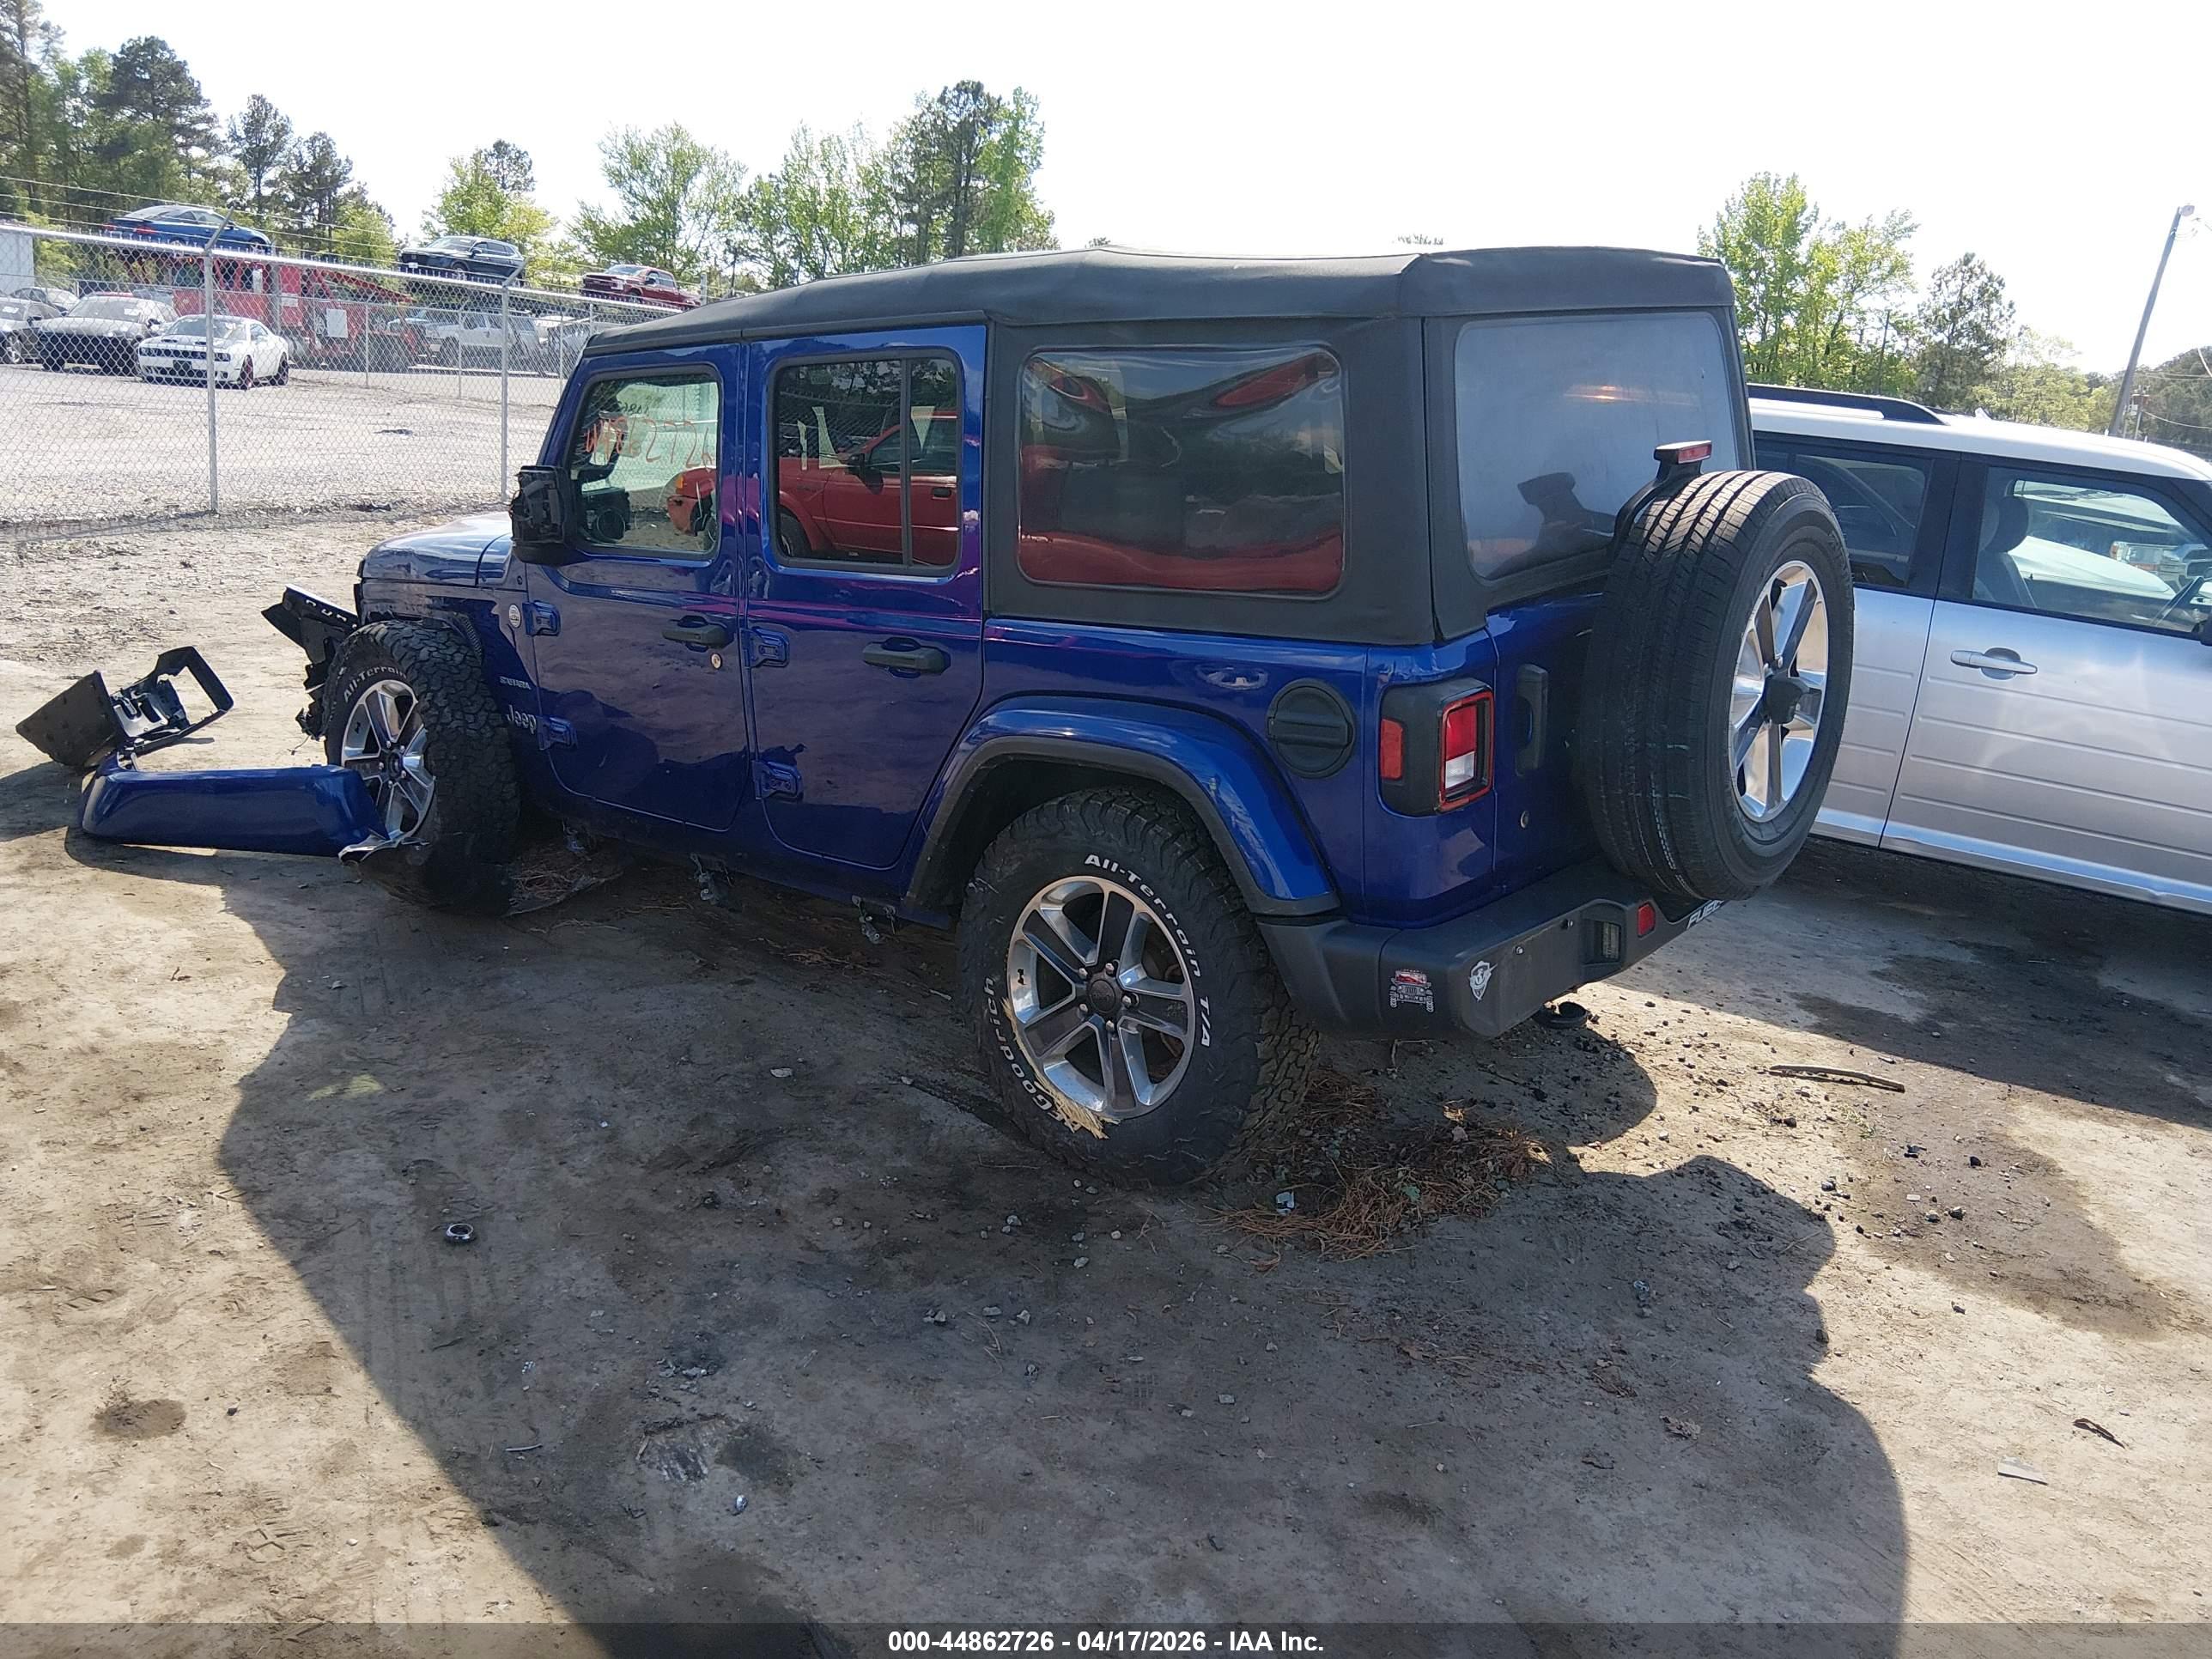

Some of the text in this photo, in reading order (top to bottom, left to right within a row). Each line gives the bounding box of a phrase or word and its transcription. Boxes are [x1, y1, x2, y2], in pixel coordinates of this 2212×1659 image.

[506, 704, 537, 735] Jeep
[1084, 854, 1211, 1048] All-Terrain T/A
